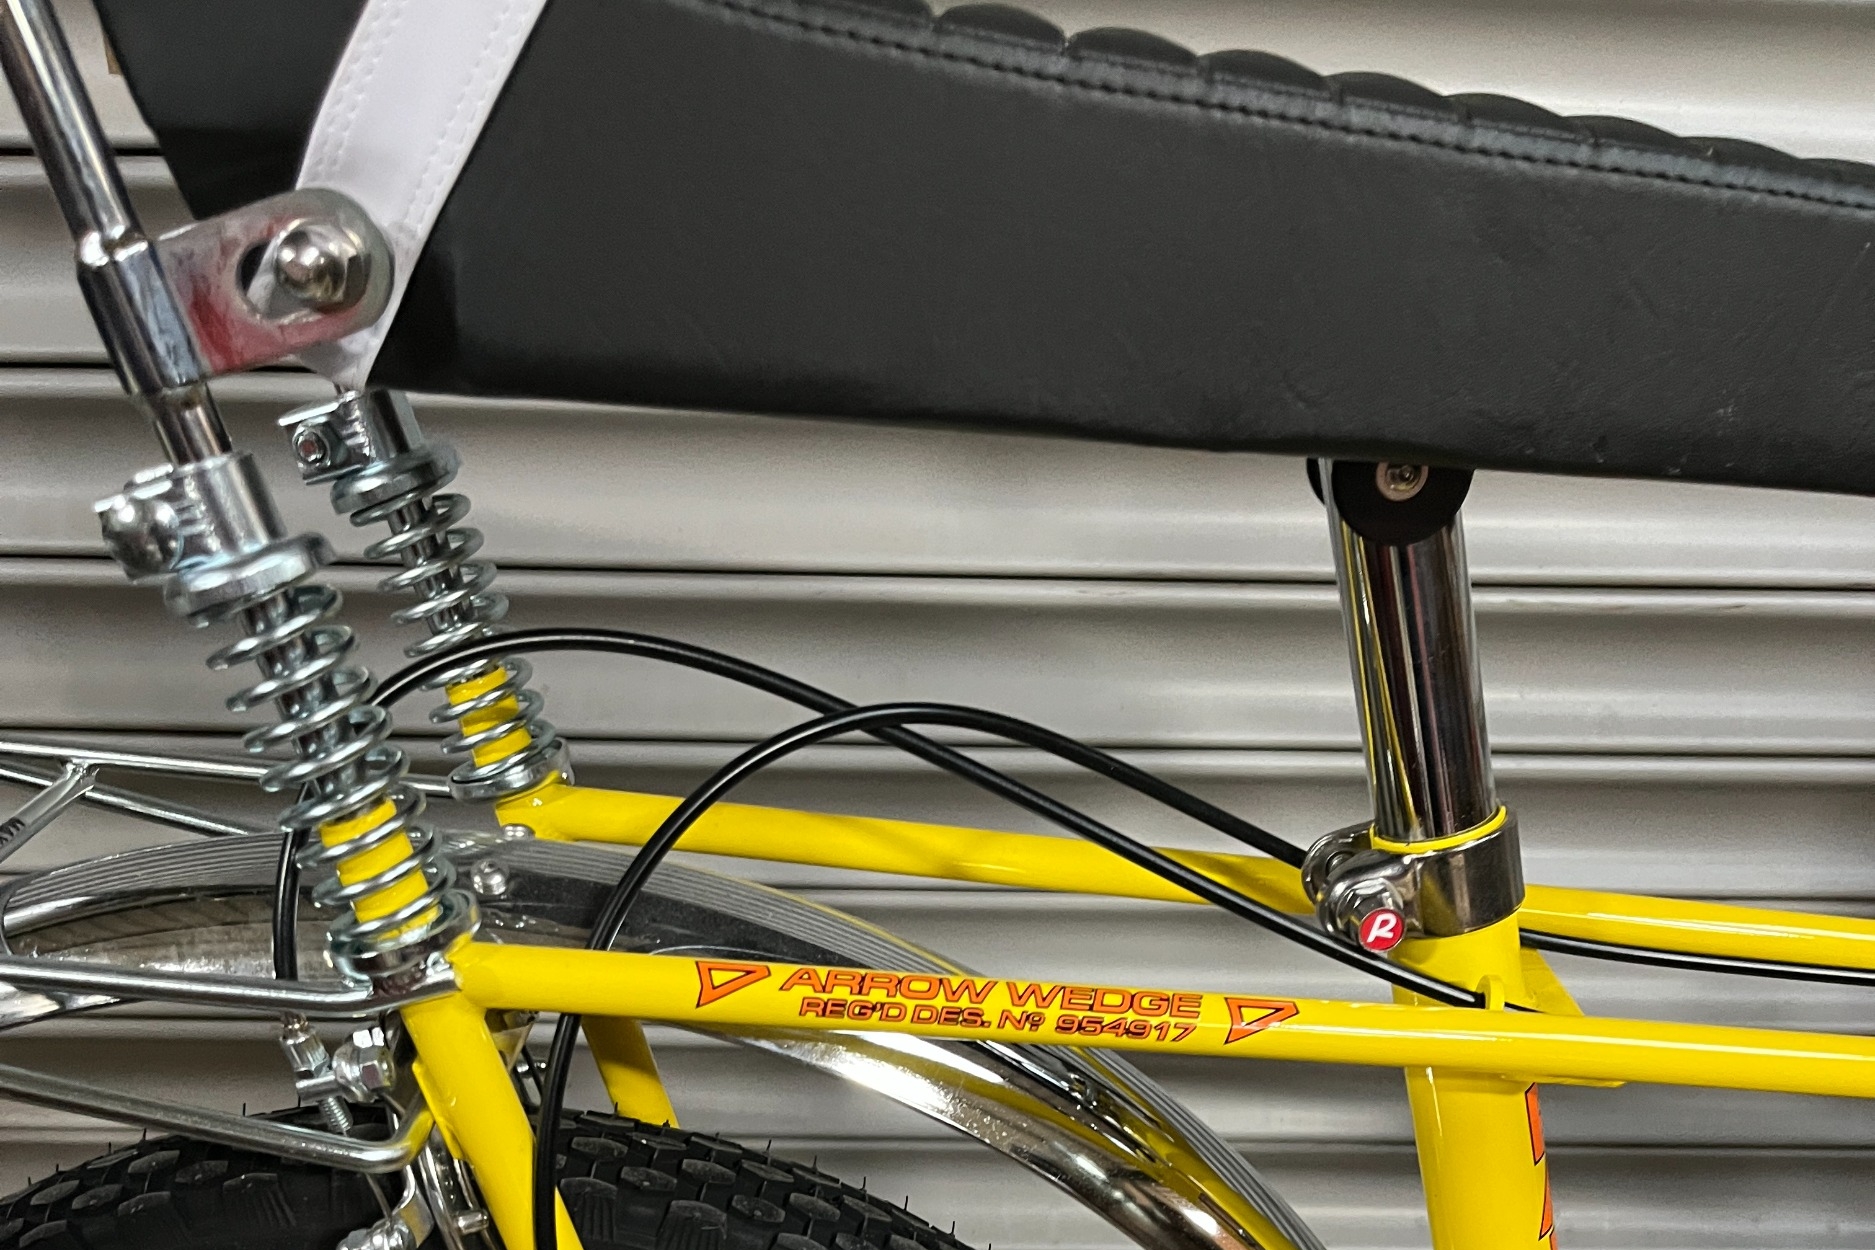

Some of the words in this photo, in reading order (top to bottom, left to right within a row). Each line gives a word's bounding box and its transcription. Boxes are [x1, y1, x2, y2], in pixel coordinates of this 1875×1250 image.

[1366, 912, 1397, 943] R
[779, 968, 997, 1004] ARROW
[1006, 981, 1203, 1019] WEDGE
[799, 997, 907, 1023] REG'D
[911, 1004, 991, 1029] DES.
[1055, 1014, 1198, 1043] 954917
